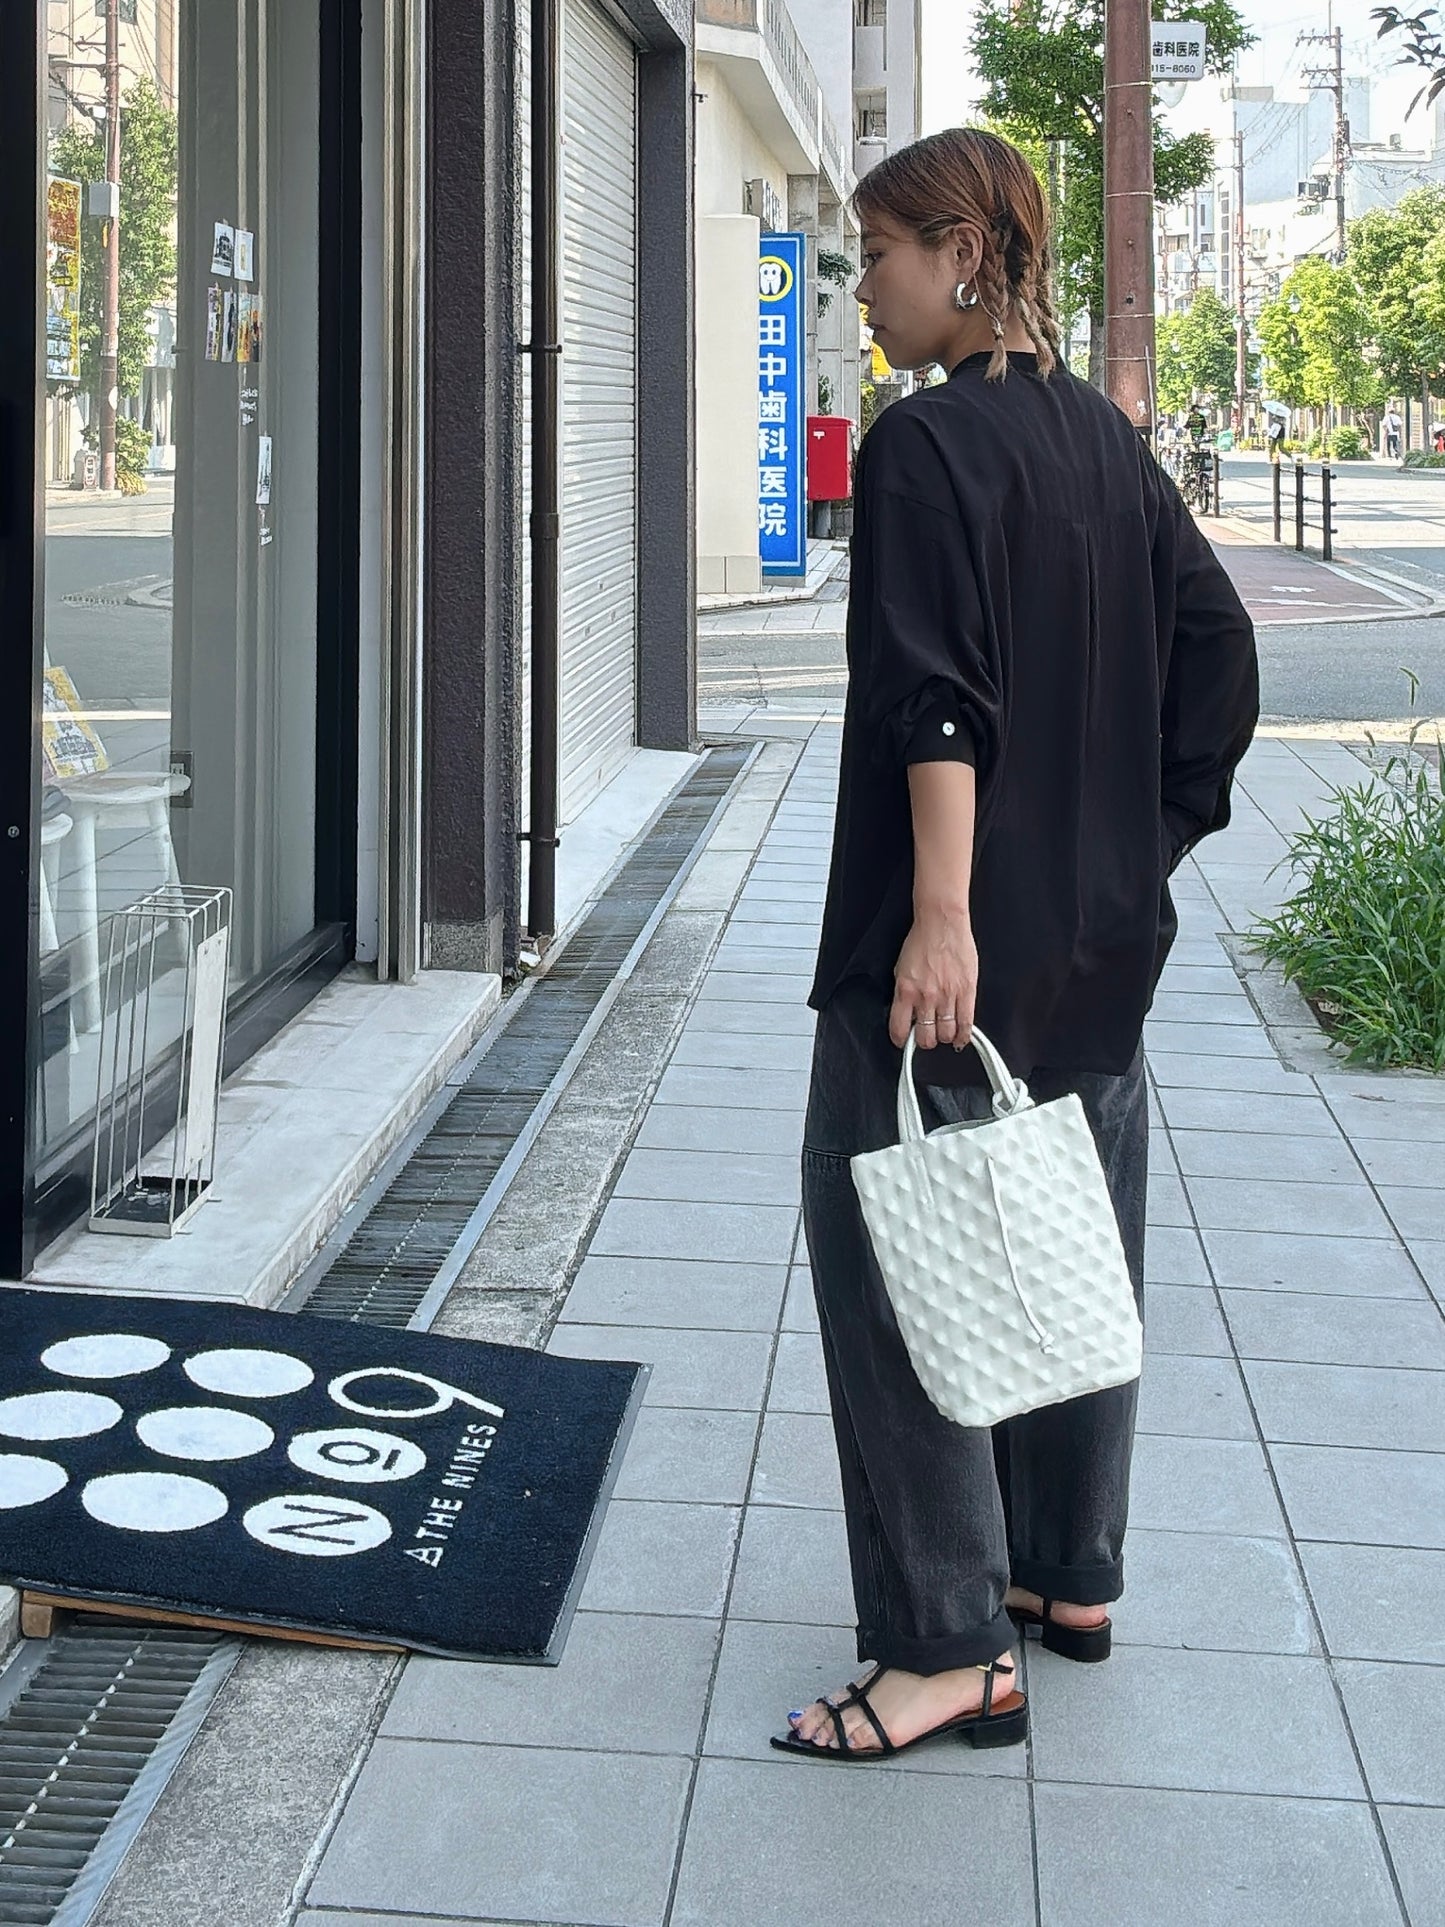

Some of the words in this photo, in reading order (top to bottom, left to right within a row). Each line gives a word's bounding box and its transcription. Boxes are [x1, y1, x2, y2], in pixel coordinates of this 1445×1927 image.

[1152, 40, 1200, 57] 歯科医院
[758, 313, 787, 537] 田中歯科医院
[440, 1422, 498, 1490] NINES
